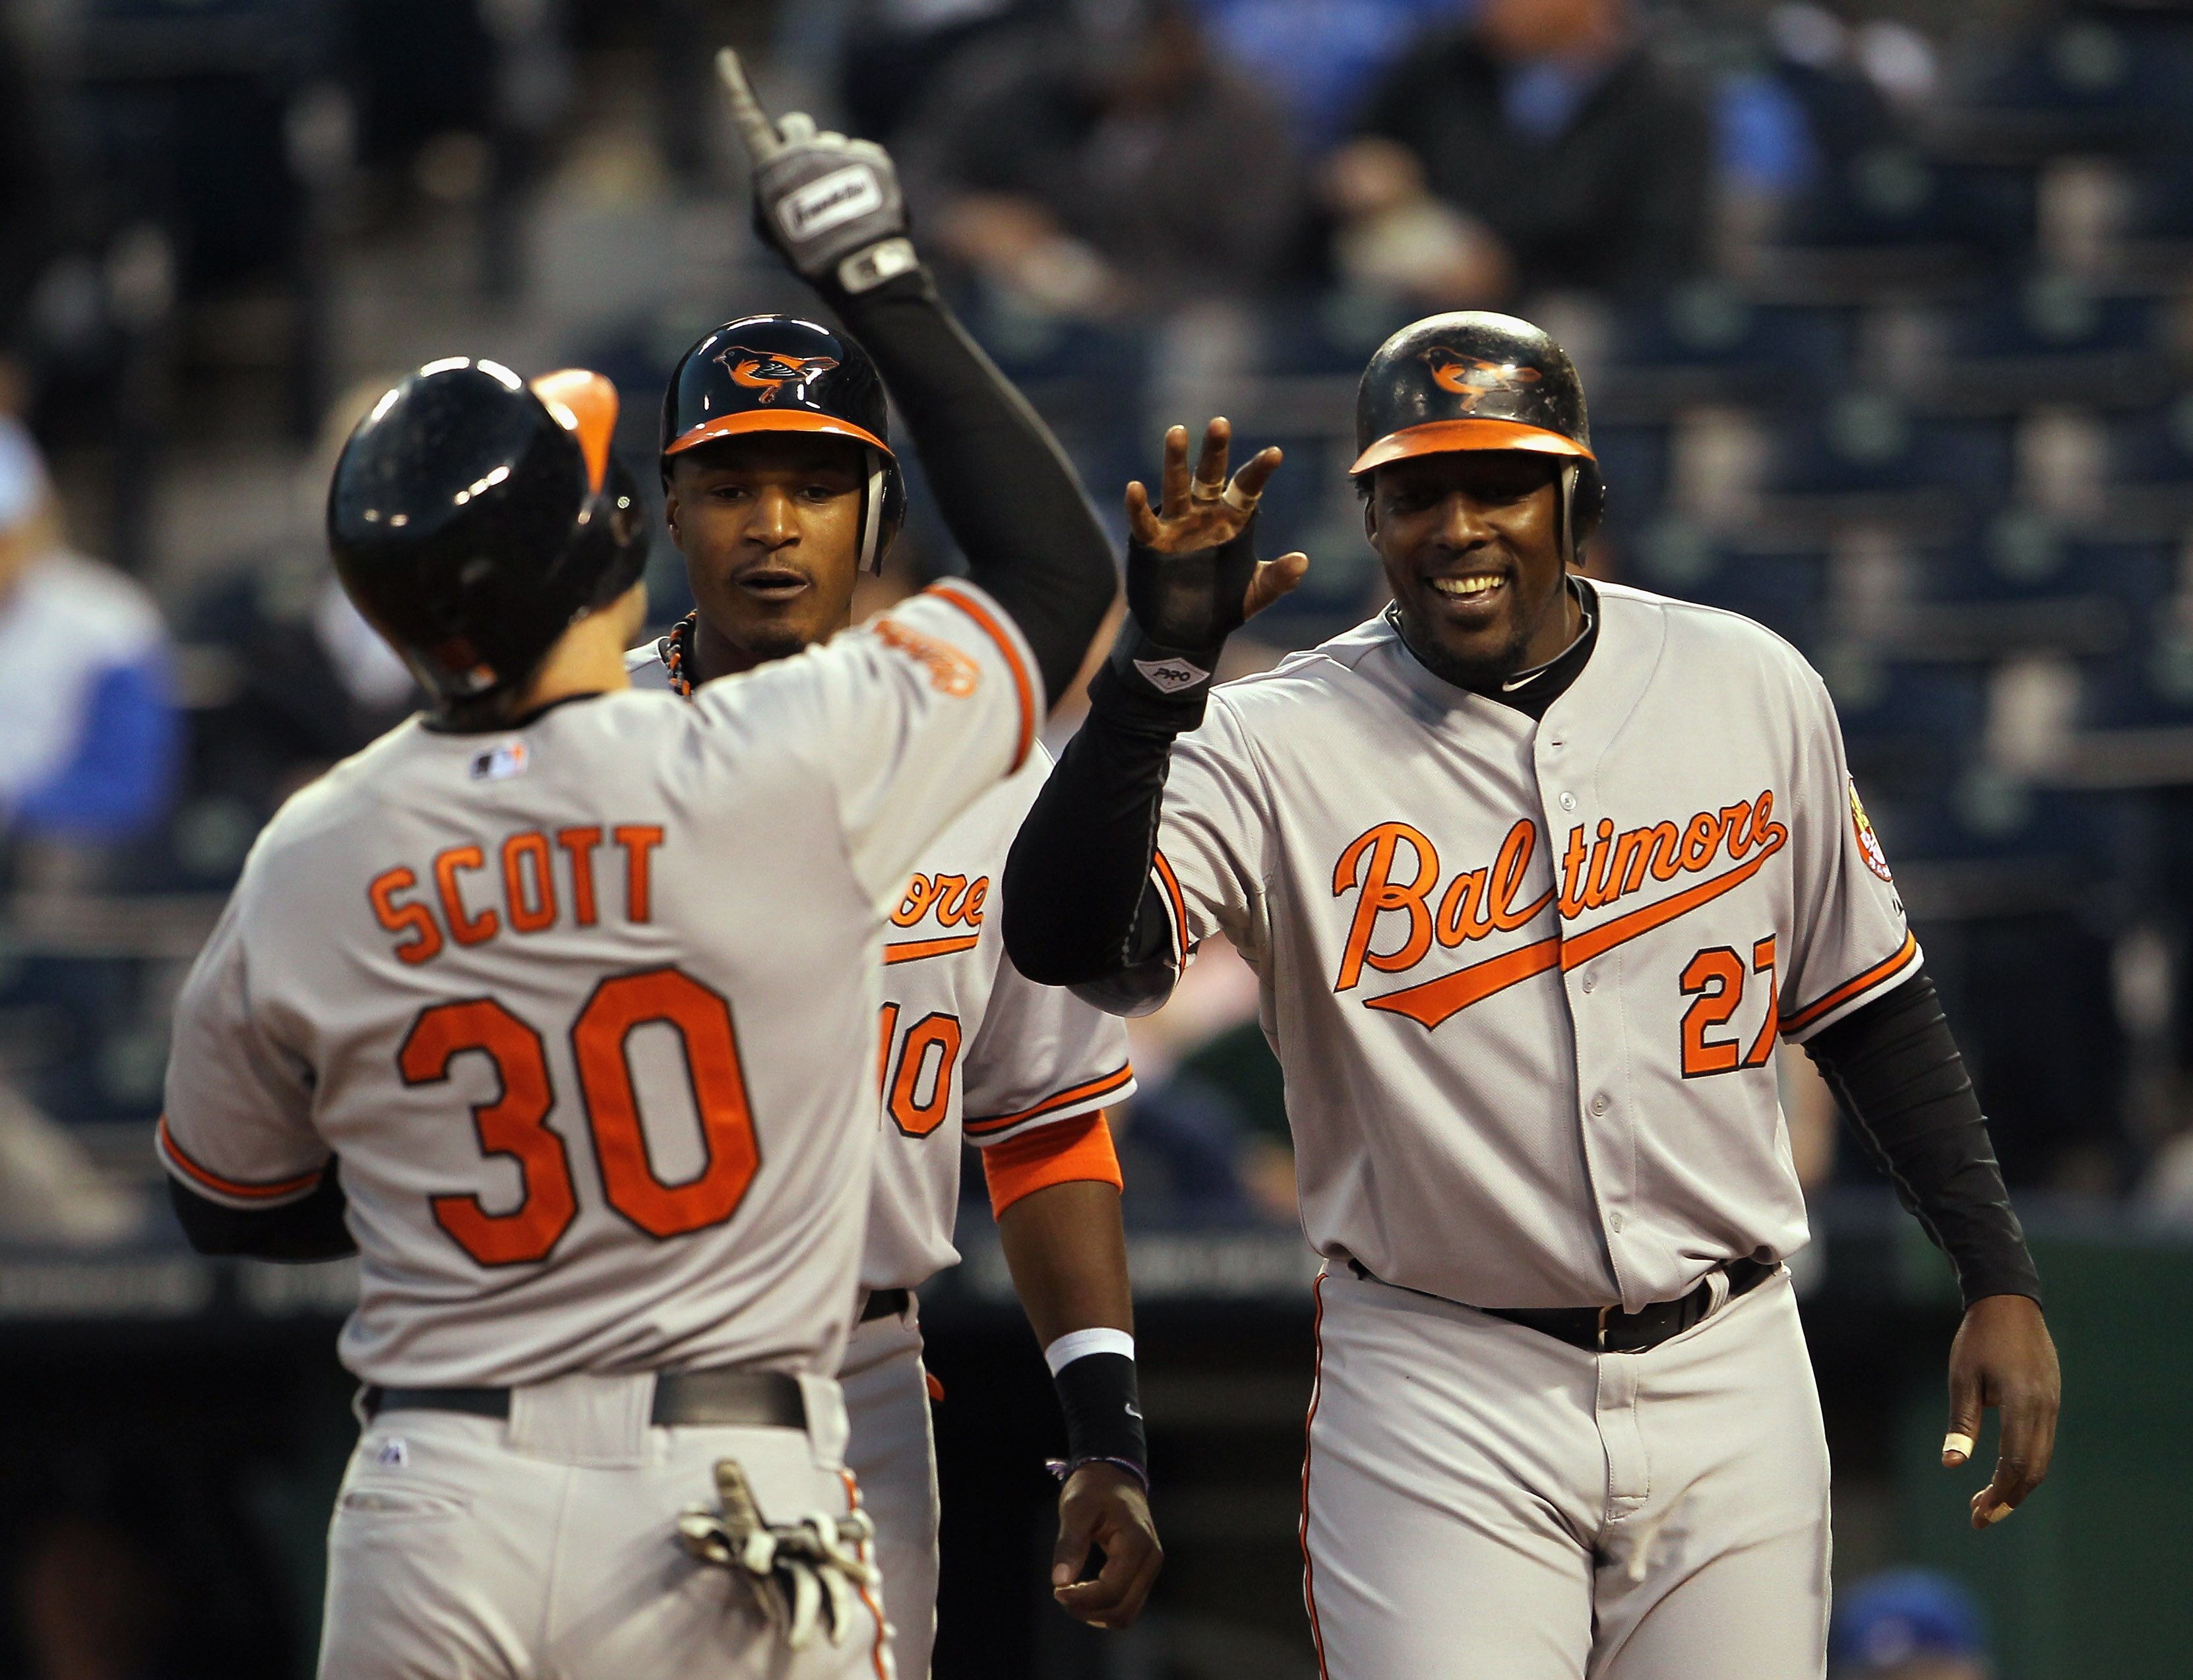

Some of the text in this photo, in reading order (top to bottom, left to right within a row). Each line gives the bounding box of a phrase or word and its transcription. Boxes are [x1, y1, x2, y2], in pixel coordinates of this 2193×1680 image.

[367, 823, 665, 967] SCOTT
[1332, 789, 1789, 993] Baltimore
[1679, 933, 1779, 1080] 27
[397, 962, 763, 1268] 30
